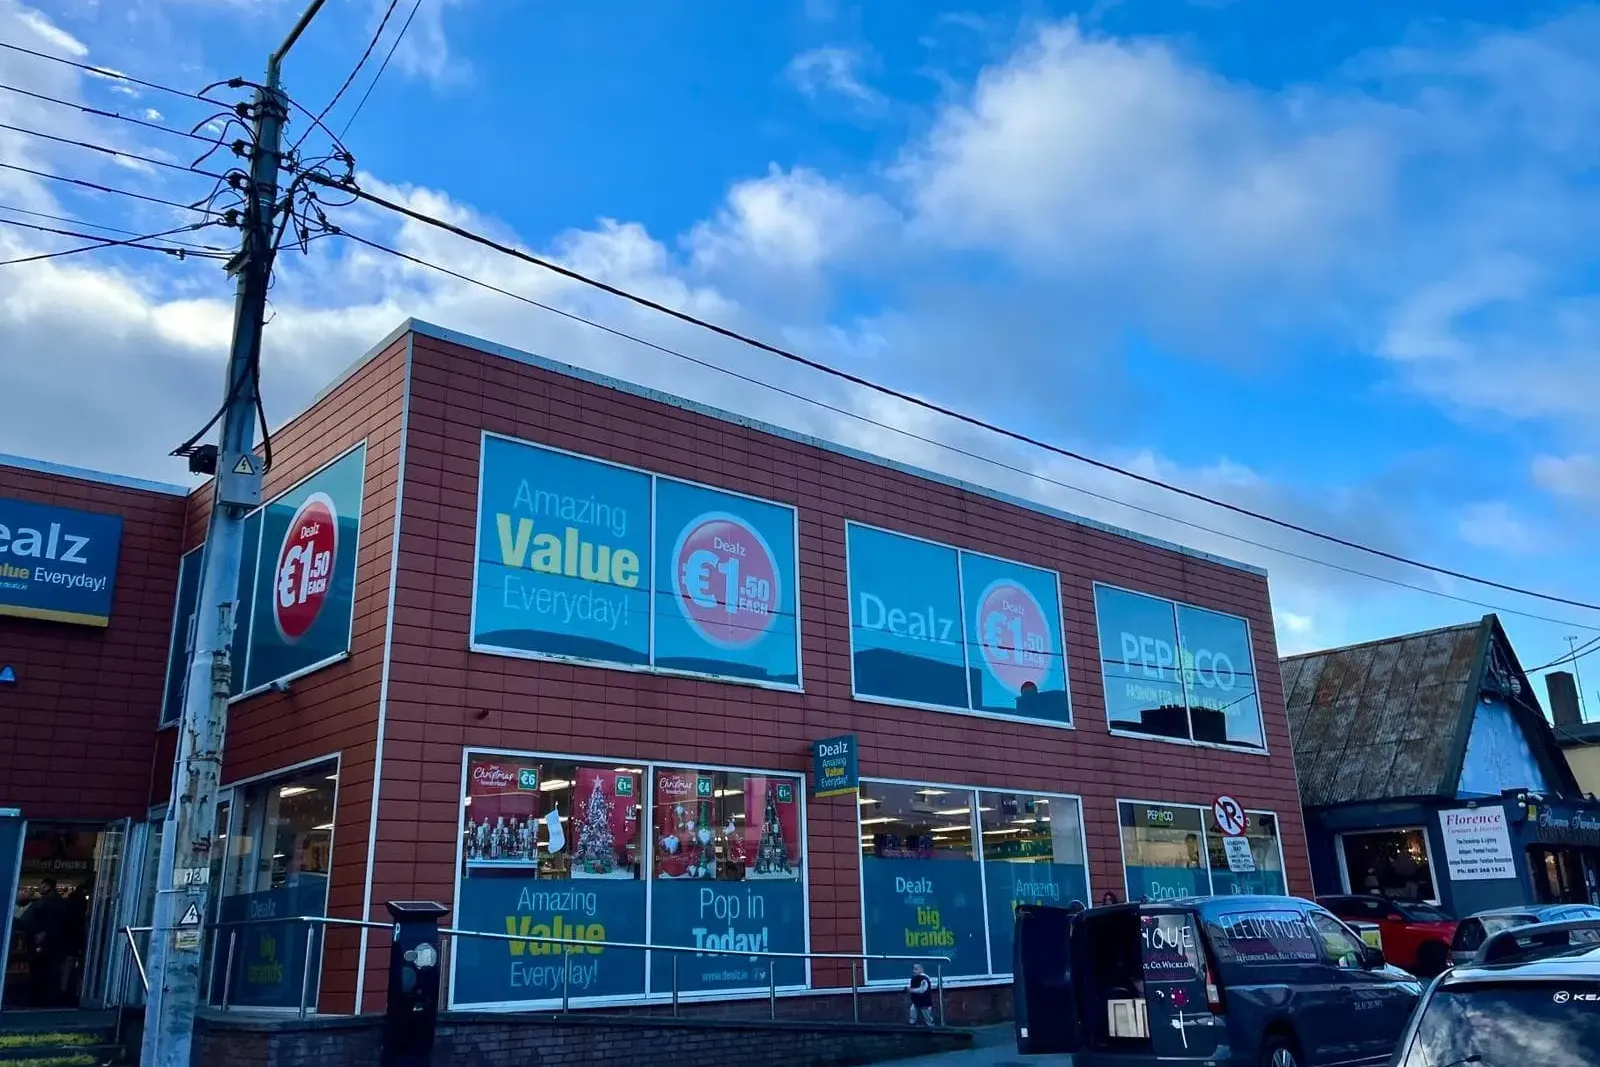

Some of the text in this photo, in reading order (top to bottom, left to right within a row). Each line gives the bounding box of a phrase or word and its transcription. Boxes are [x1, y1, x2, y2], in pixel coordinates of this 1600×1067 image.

[513, 478, 626, 538] Amazing
[301, 522, 320, 540] Dealz
[496, 512, 640, 588] Value
[714, 536, 746, 556] Dealz
[0, 563, 30, 579] lue
[34, 566, 107, 592] Everyday!
[308, 577, 328, 595] EACH
[504, 575, 628, 631] Everyday!
[739, 598, 768, 616] EACH
[1002, 600, 1025, 615] Dealz
[860, 591, 956, 646] Dealz
[819, 741, 848, 757] Dealz
[823, 757, 847, 768] Amazing
[825, 767, 845, 777] Value
[474, 766, 514, 781] Christmas
[521, 771, 536, 786] €6
[660, 777, 693, 790] Christmas
[821, 774, 848, 788] Everyday!
[1446, 813, 1501, 826] Florence
[895, 876, 933, 893] Dealz
[1015, 878, 1060, 901] Amazing
[250, 898, 277, 919] Dealz
[517, 886, 597, 916] Amazing
[700, 887, 764, 927] Pop in
[917, 905, 940, 930] big
[505, 915, 606, 956] Value
[692, 926, 768, 962] Today!
[904, 927, 955, 949] brands
[510, 959, 598, 991] Everyday!
